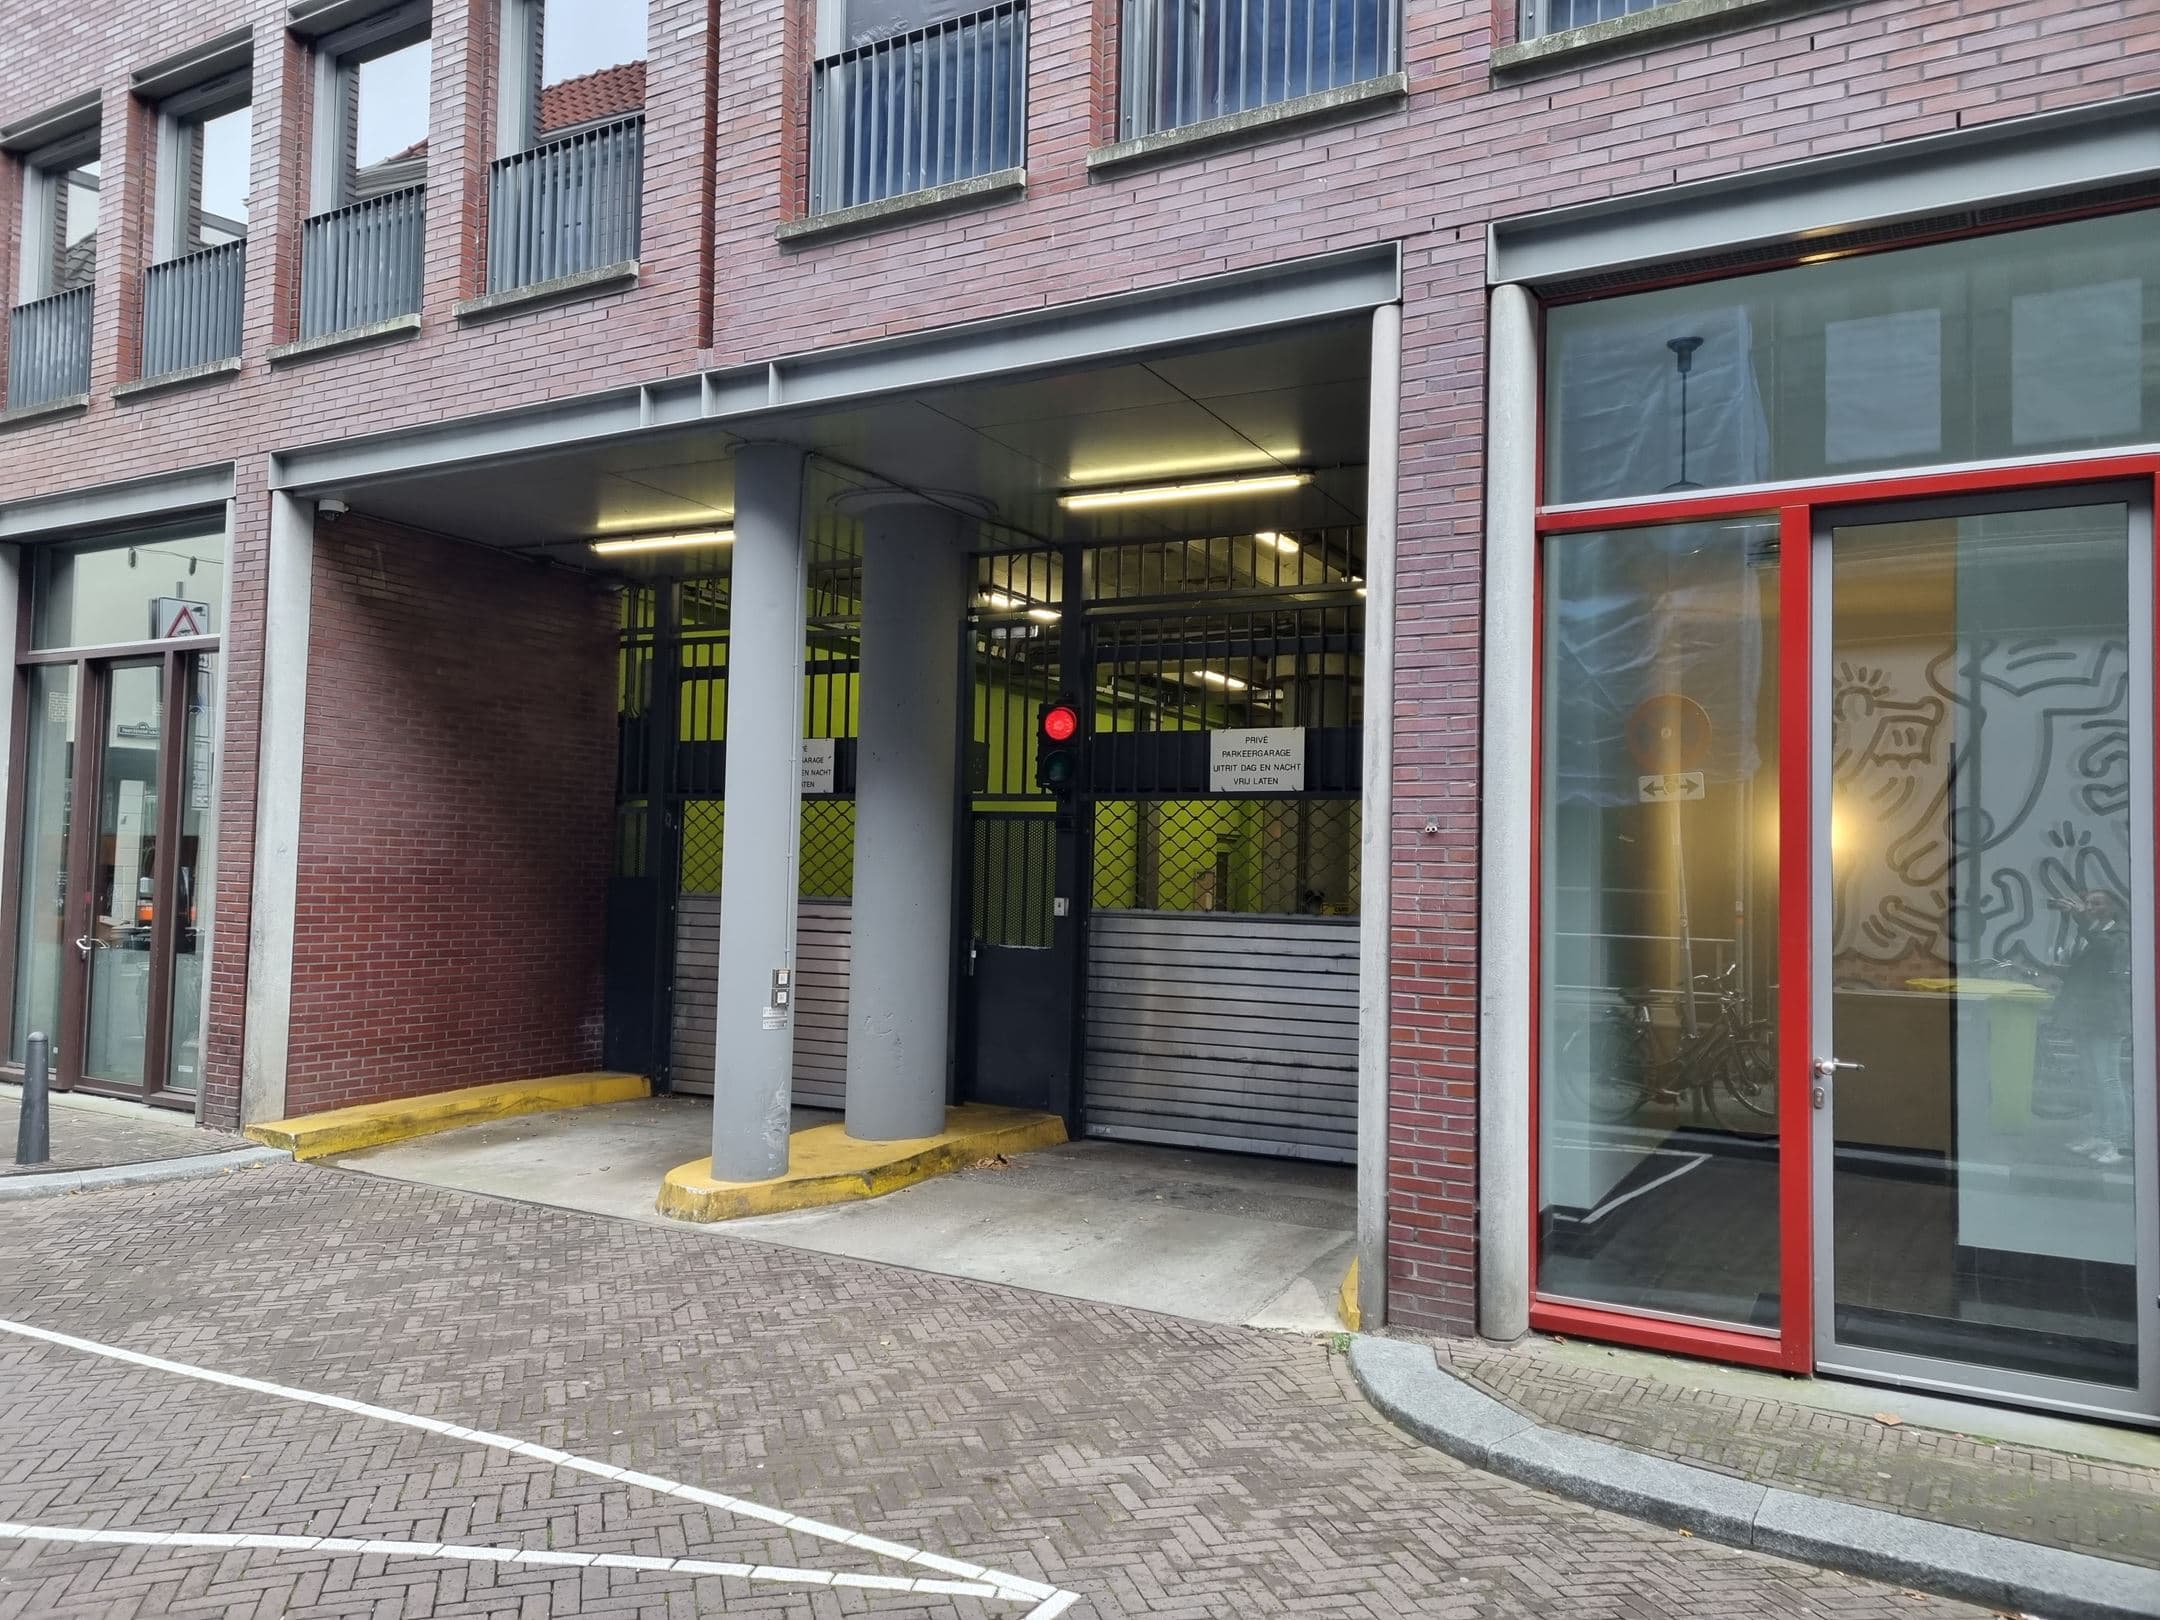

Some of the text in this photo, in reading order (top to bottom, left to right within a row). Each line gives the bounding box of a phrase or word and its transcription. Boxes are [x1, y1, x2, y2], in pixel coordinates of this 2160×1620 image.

[1222, 749, 1291, 758] PARKEERGARAGE
[1241, 764, 1257, 772] DAG
[1260, 764, 1271, 772] EN
[1274, 763, 1301, 771] NACHT
